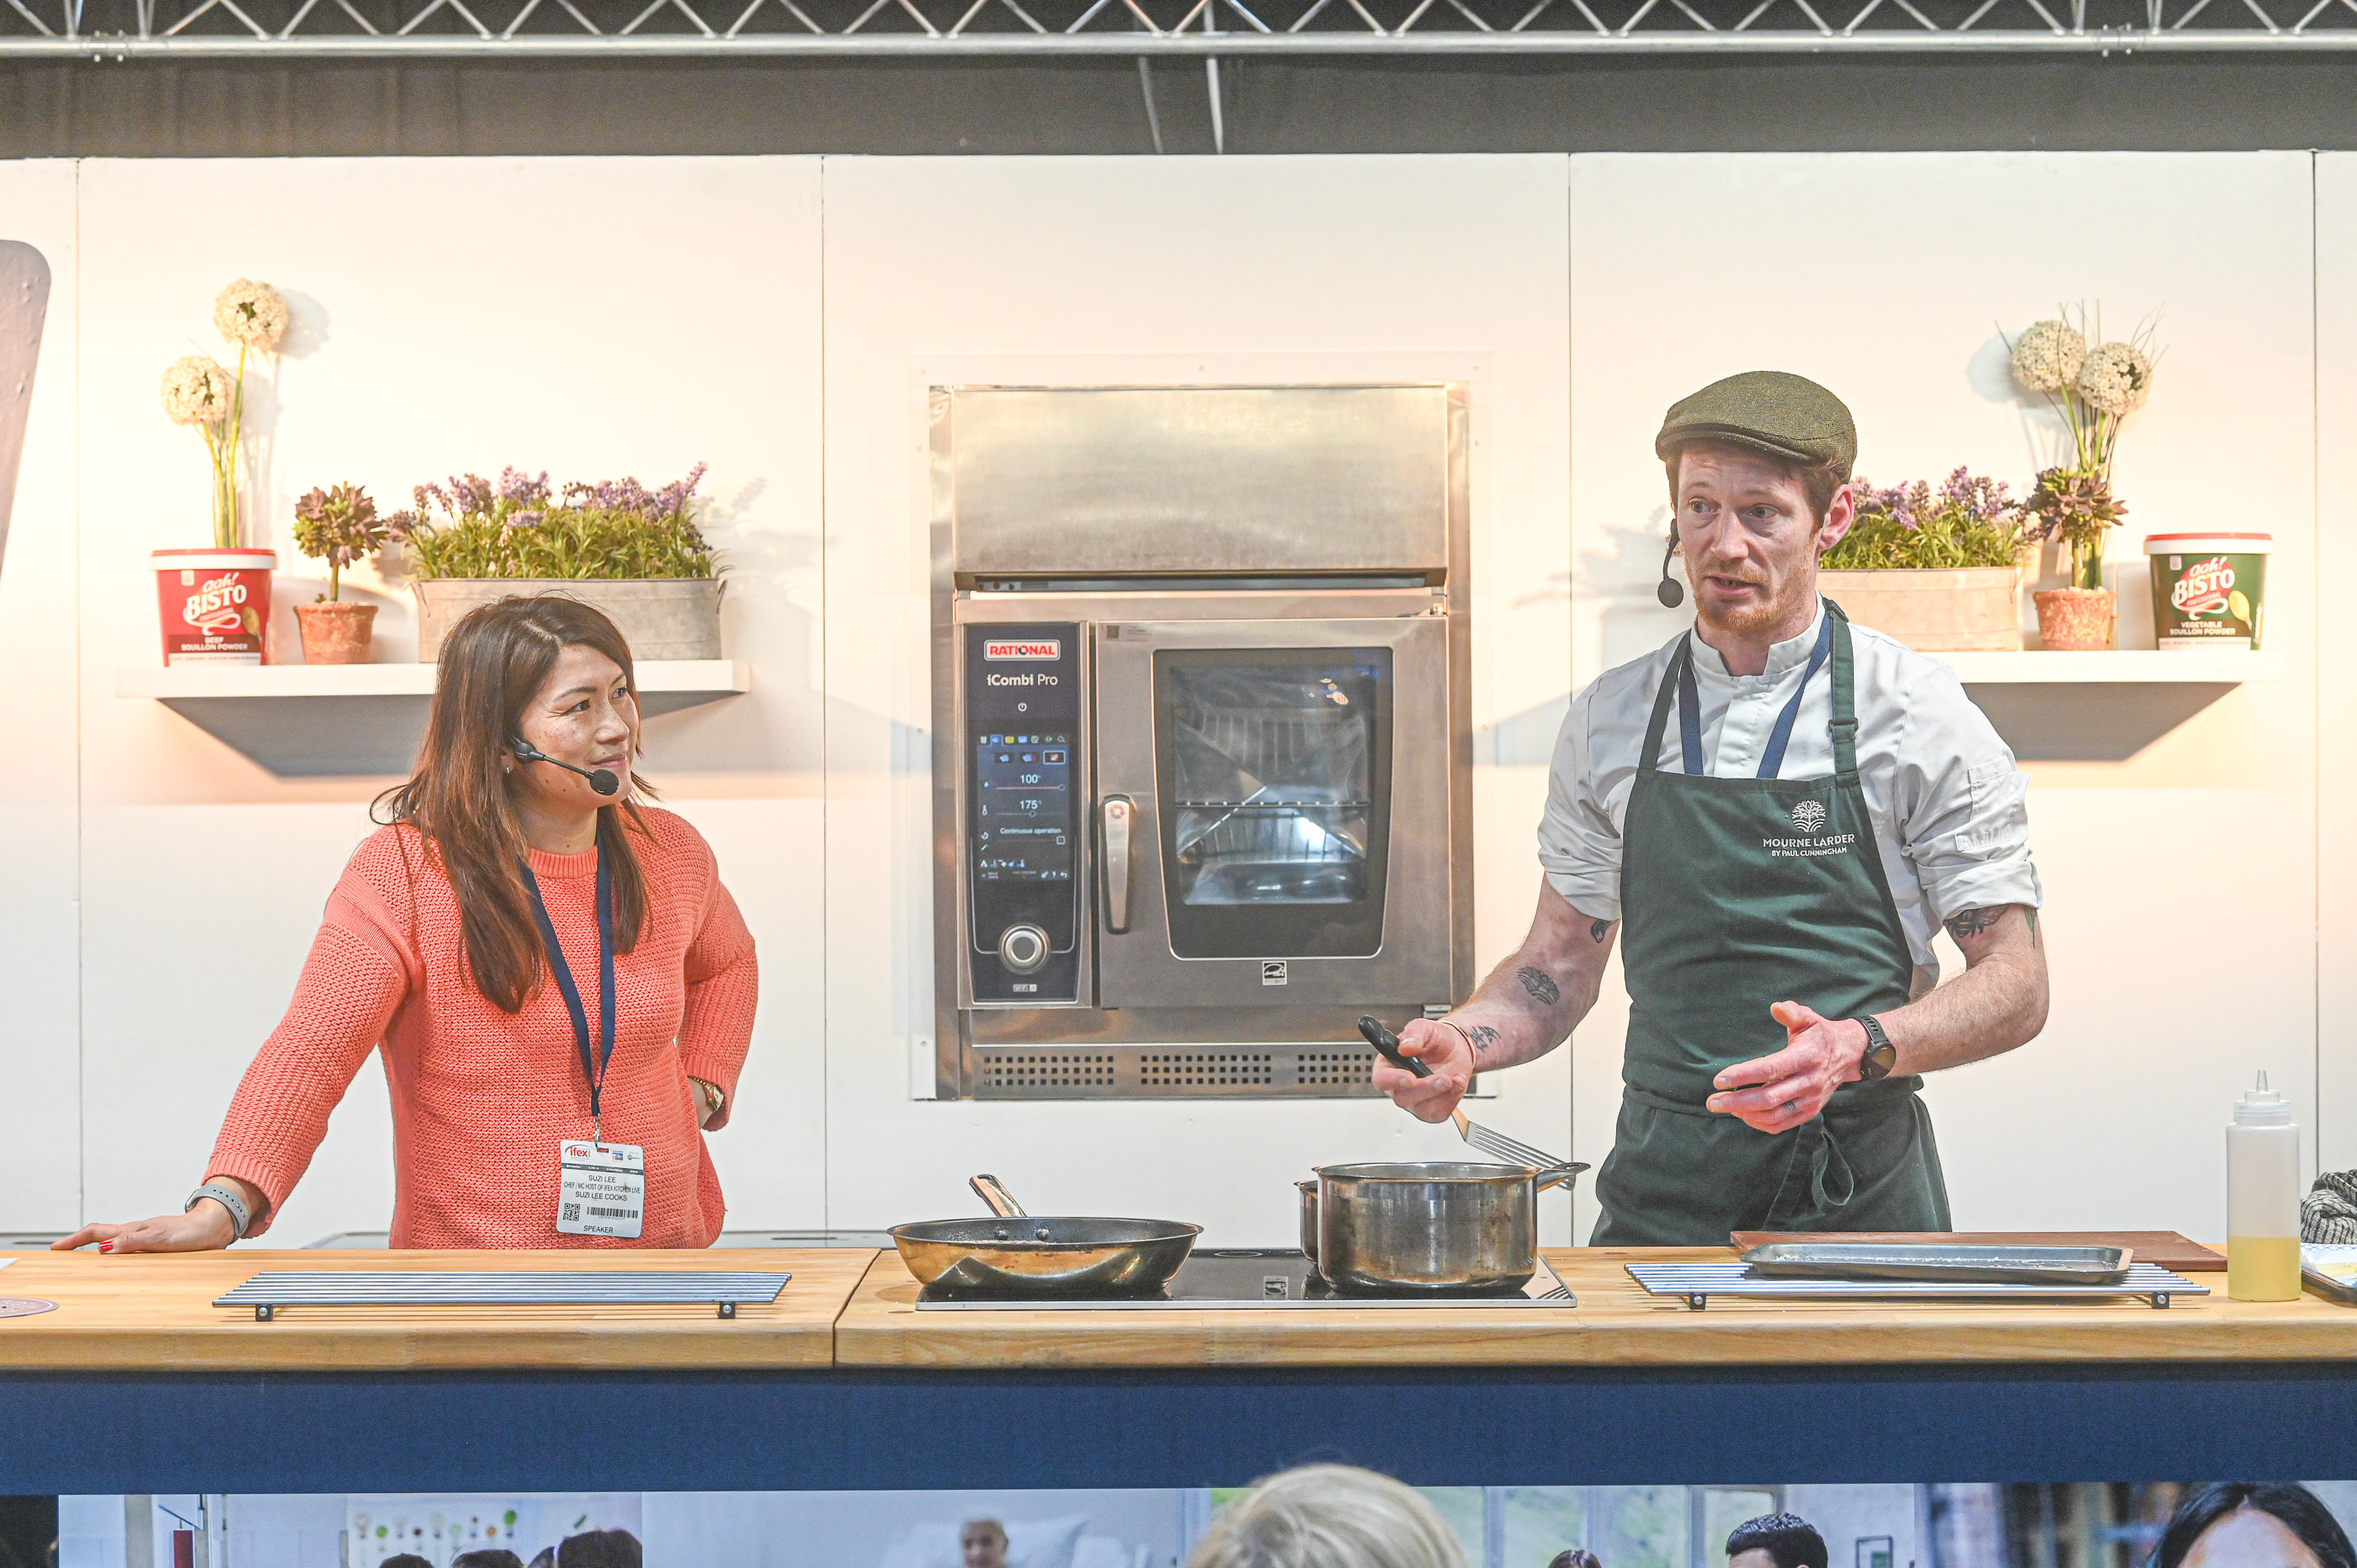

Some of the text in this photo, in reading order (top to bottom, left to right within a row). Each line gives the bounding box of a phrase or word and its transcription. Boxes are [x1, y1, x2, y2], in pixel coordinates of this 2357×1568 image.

[2189, 555, 2227, 578] aah!
[2174, 568, 2236, 605] BISTO
[186, 584, 247, 620] BISTO
[2180, 620, 2223, 629] VEGETABLE
[2204, 627, 2237, 635] POWDER
[989, 645, 1056, 656] RATIONAL
[987, 673, 1058, 686] iCombi Pro
[1763, 833, 1855, 848] MOURNE LARDER
[1800, 847, 1847, 857] CUNNINGHAM
[570, 1146, 588, 1157] ifex
[613, 1185, 631, 1193] KITCHEN
[604, 1193, 628, 1202] COOKS
[583, 1225, 614, 1234] SPEAKER
